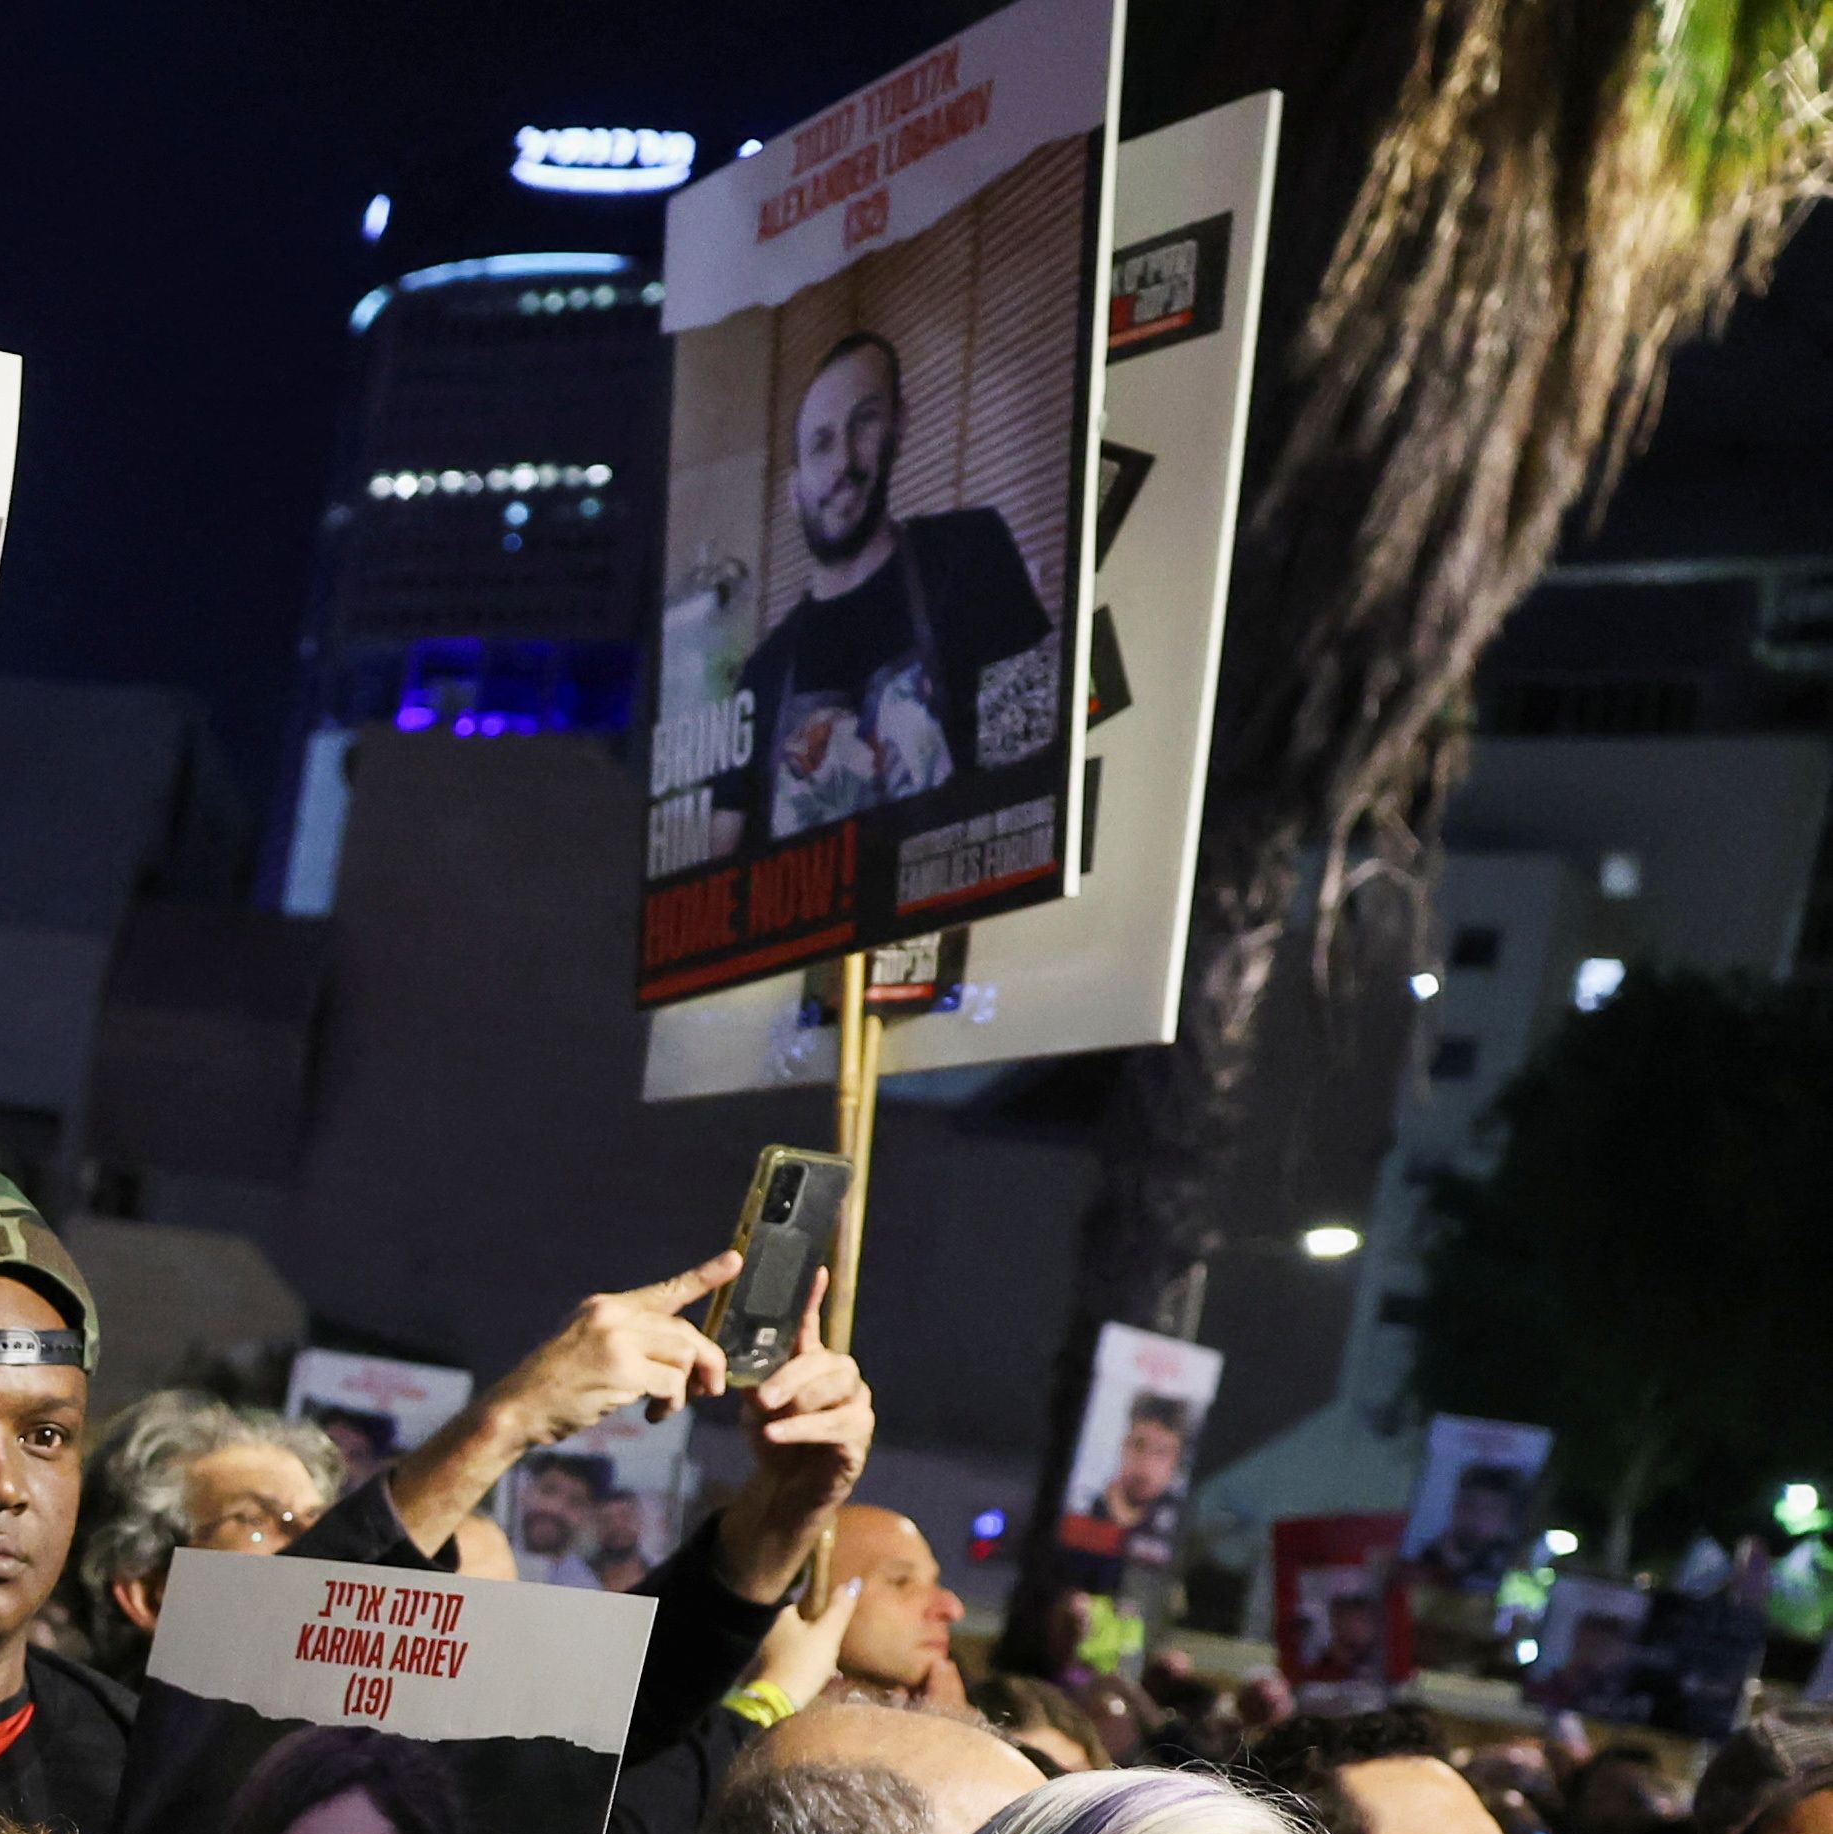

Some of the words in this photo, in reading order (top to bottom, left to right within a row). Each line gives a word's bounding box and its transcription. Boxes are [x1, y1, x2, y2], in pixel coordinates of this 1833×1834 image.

[757, 143, 879, 245] ALEXANDER
[650, 688, 756, 798] BRING
[642, 866, 743, 970] HOME
[317, 1579, 388, 1624] ארייב
[389, 1587, 465, 1636] קרינה
[295, 1622, 386, 1670] KARINA
[388, 1634, 470, 1680] ARIEV
[342, 1672, 394, 1721] (19)
